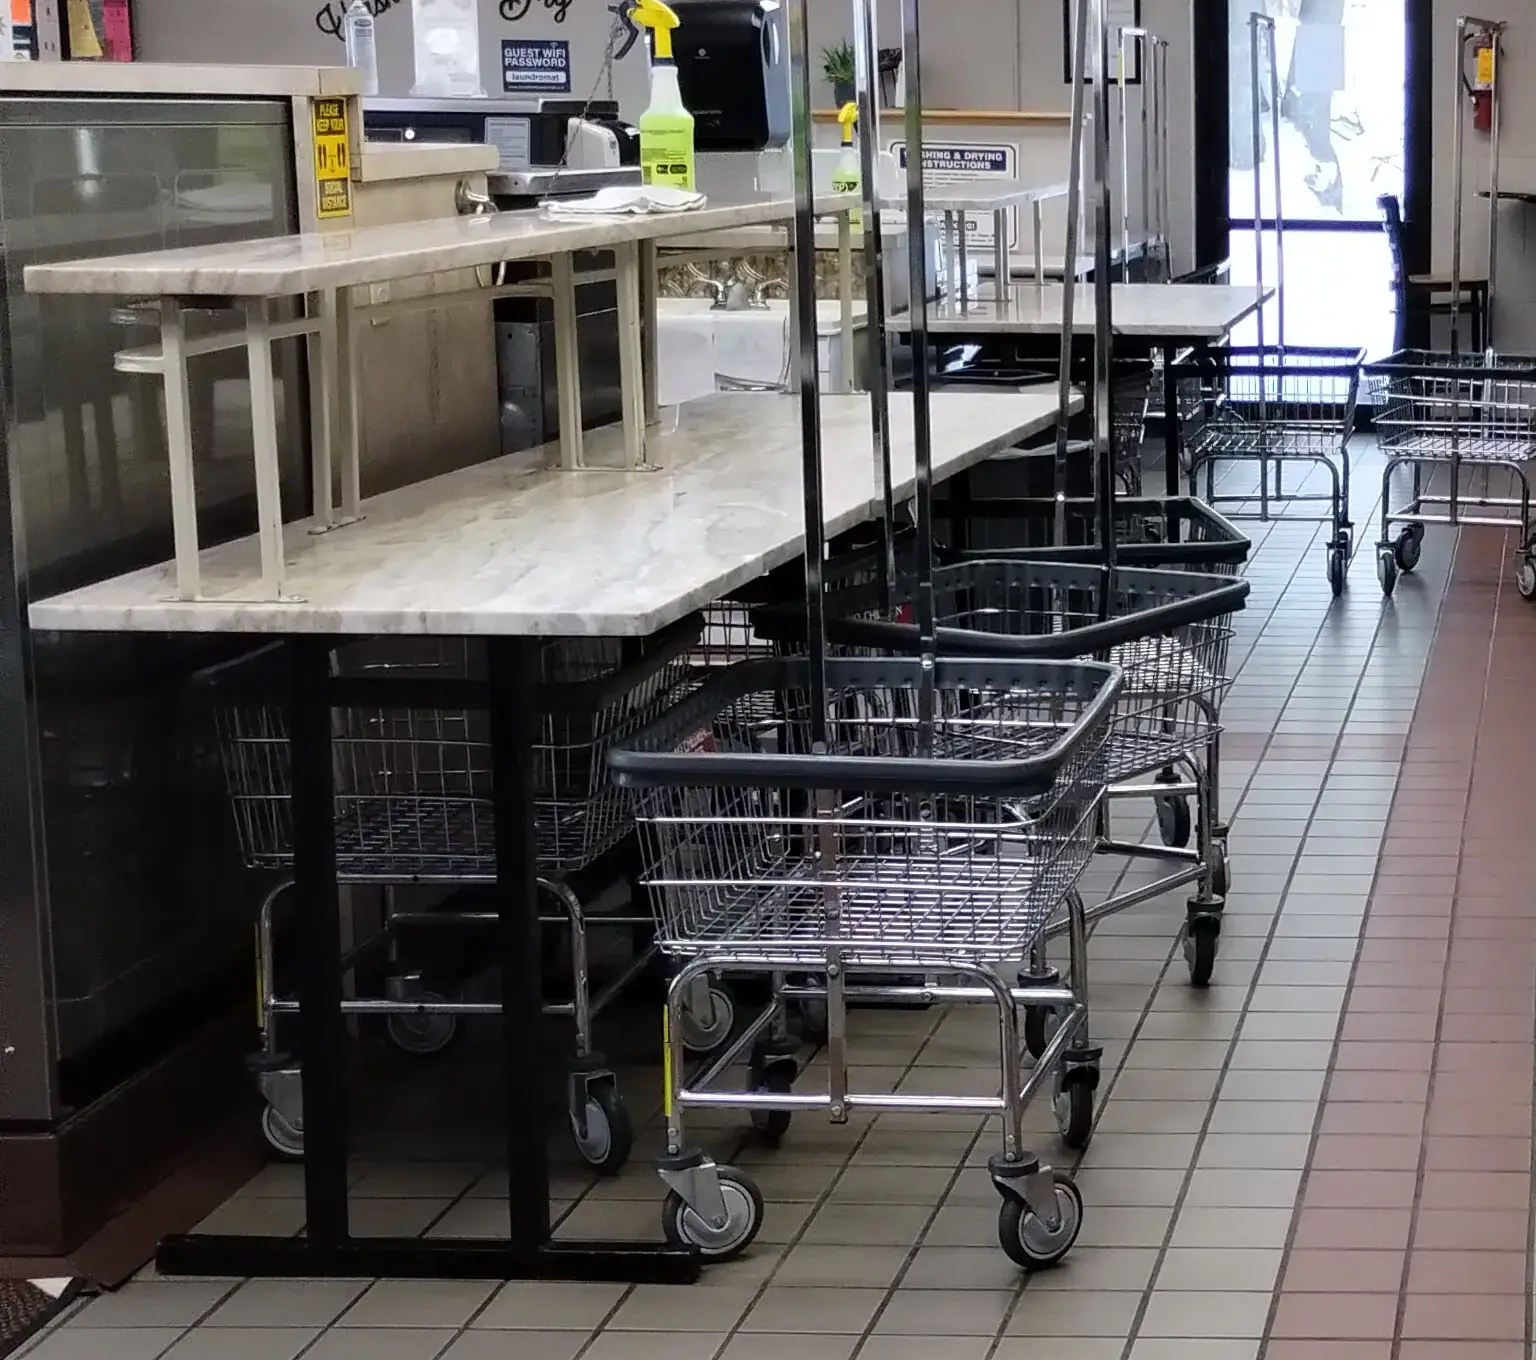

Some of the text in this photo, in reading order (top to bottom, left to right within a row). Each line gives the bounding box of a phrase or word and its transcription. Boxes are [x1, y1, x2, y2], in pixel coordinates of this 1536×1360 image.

[504, 48, 566, 58] GUEST WIFI
[504, 57, 566, 67] PASSWORD
[512, 73, 559, 81] laundromat
[953, 151, 961, 160] &
[964, 152, 1003, 162] DRYING
